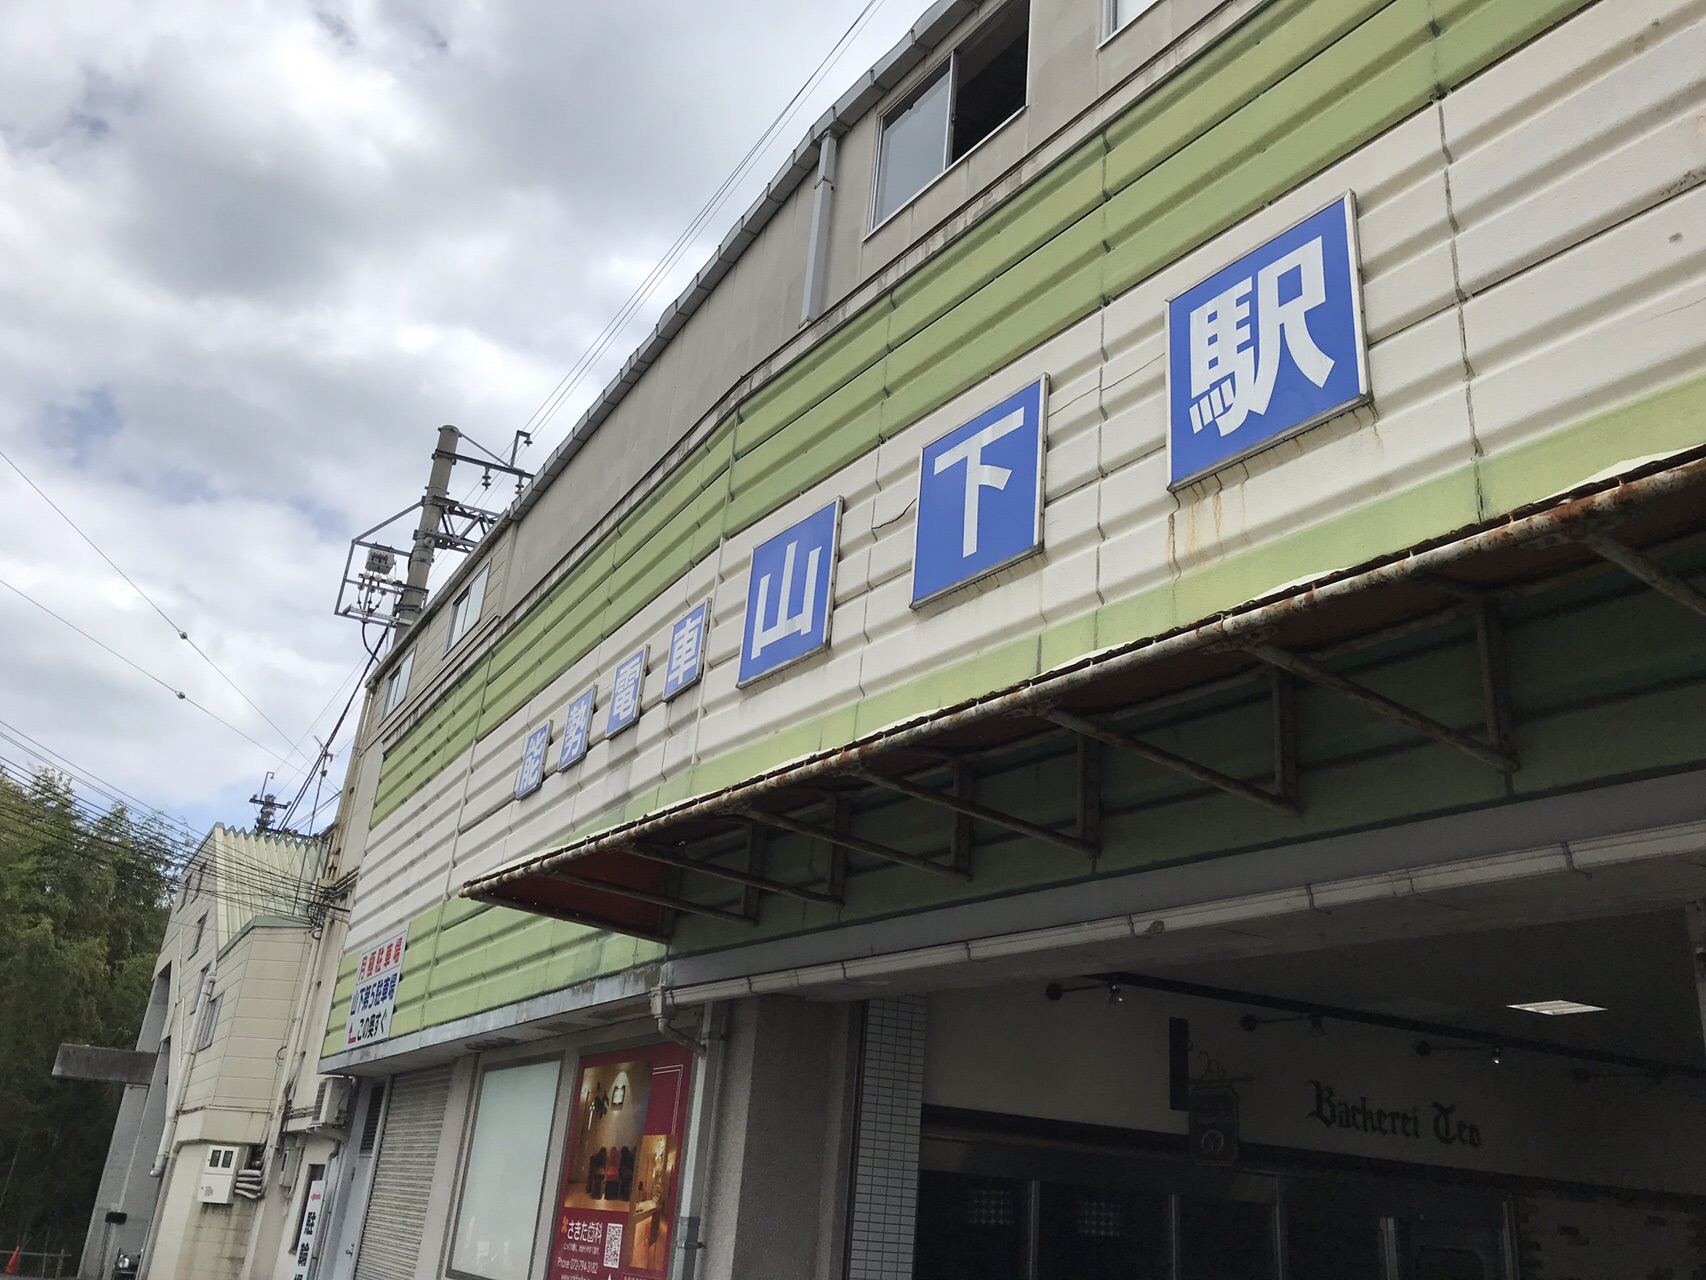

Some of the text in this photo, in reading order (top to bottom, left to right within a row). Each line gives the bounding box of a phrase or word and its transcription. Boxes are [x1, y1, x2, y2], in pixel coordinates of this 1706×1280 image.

[519, 235, 1336, 791] 能勢電車 山下駅
[359, 937, 403, 981] 月極駐車場
[357, 1008, 388, 1041] この奥すぐ
[567, 1219, 603, 1244] さきた歯科
[557, 1257, 570, 1270] Phone
